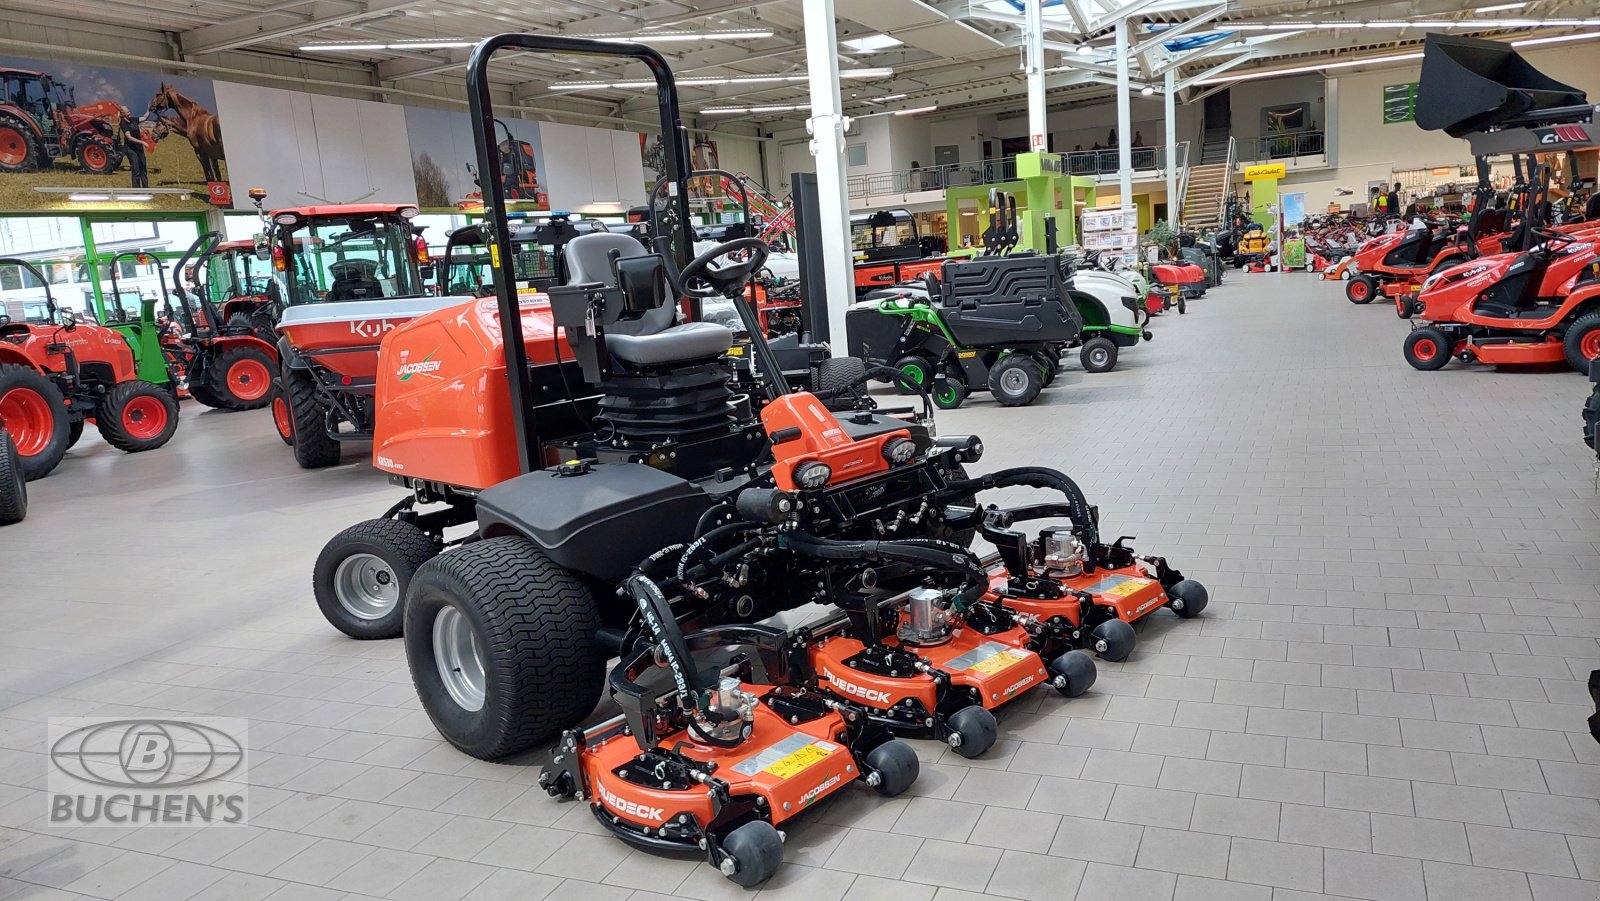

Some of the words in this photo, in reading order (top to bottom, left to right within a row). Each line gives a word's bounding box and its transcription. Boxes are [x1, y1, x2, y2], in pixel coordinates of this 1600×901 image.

[1567, 242, 1592, 254] Kubota
[1462, 265, 1487, 278] Kubota
[396, 360, 442, 376] JACOBSEN
[822, 666, 892, 704] TRUEDECK
[1002, 675, 1035, 696] JACOBSEN
[798, 773, 842, 805] JACOBSEN
